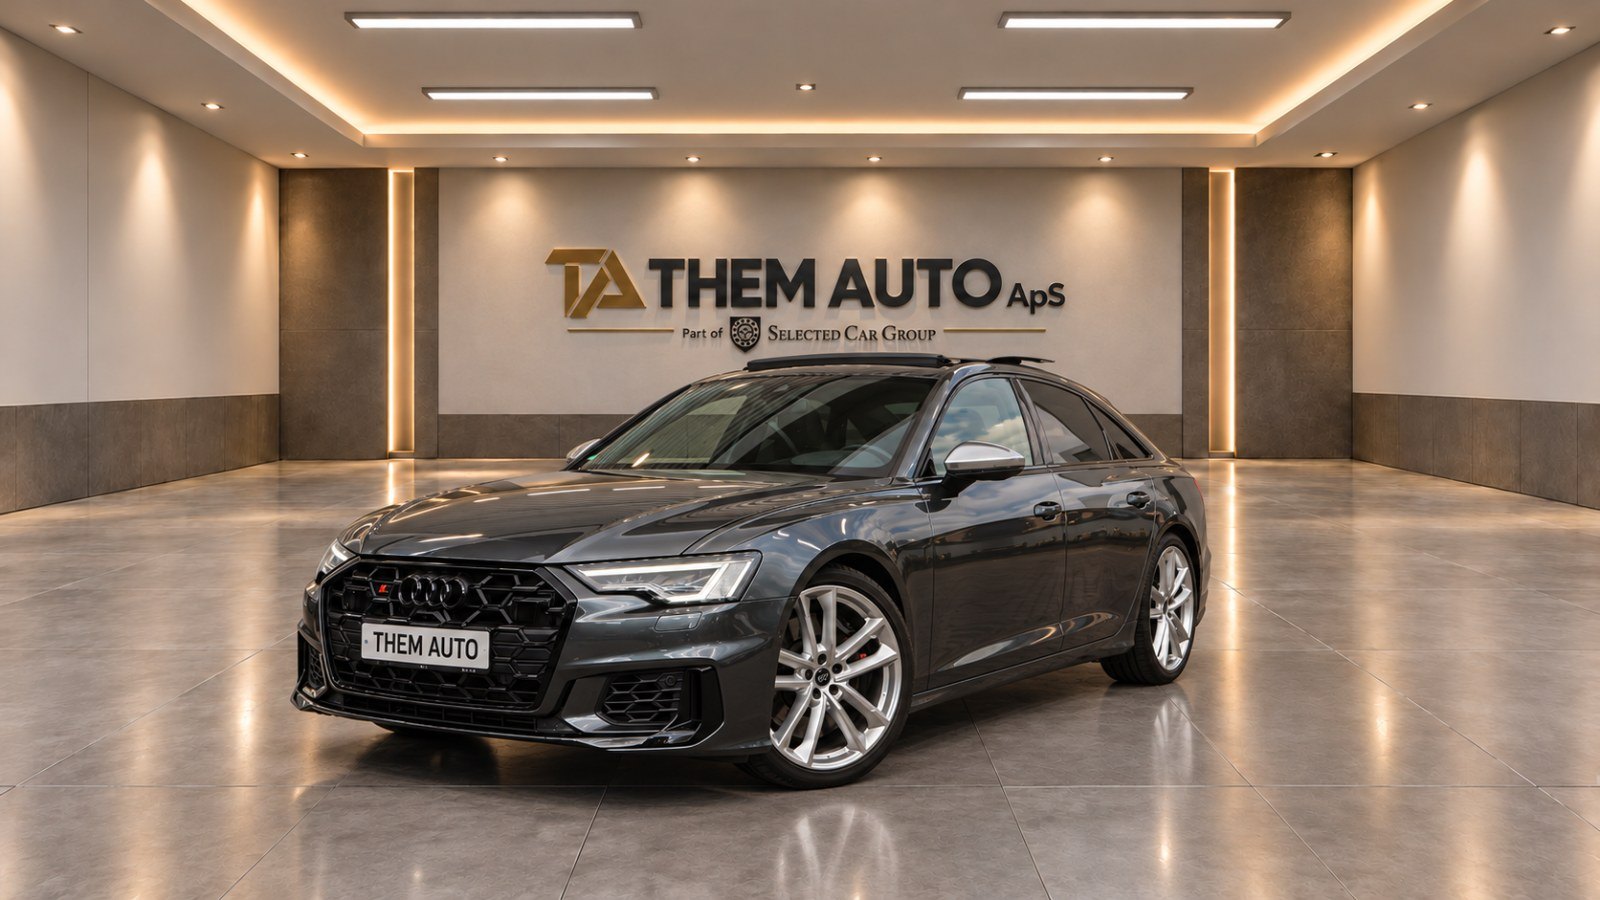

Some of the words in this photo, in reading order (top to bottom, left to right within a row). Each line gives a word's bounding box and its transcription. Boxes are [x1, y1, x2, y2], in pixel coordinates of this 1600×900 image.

[648, 258, 816, 308] THEM
[828, 258, 1002, 309] AUTO
[1007, 282, 1066, 315] ApS
[682, 328, 707, 339] Part
[710, 327, 724, 339] of
[768, 325, 841, 342] SELECTED
[844, 325, 878, 342] CAR
[881, 325, 937, 342] GROUP
[373, 631, 423, 656] THEM
[428, 635, 479, 660] AUTO
